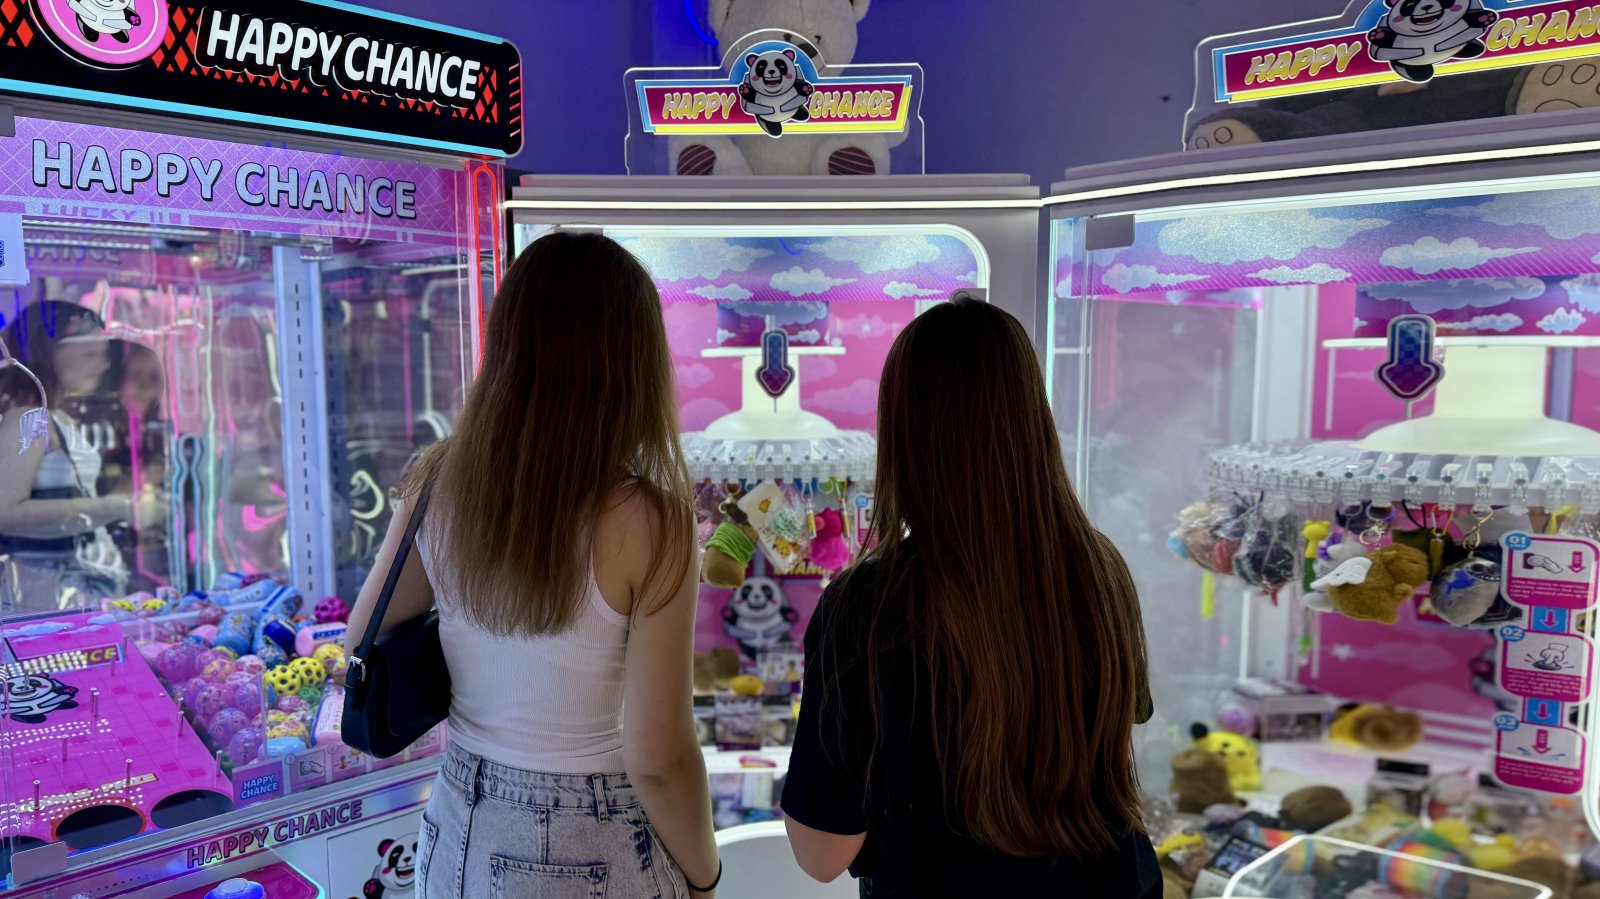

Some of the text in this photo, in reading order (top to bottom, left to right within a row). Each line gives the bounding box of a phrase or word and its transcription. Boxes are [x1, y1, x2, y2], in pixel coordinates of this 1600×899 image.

[206, 10, 481, 100] HAPPY CHANCE
[1243, 4, 1600, 85] HAPPY CHAN
[661, 89, 895, 120] HAPPY CHANCE
[32, 138, 417, 219] HAPPY CHANCE
[41, 203, 137, 220] LUCKY
[240, 782, 278, 799] CHANCE
[243, 774, 275, 790] HAPPY
[186, 800, 363, 869] HAPPY CHANCE
